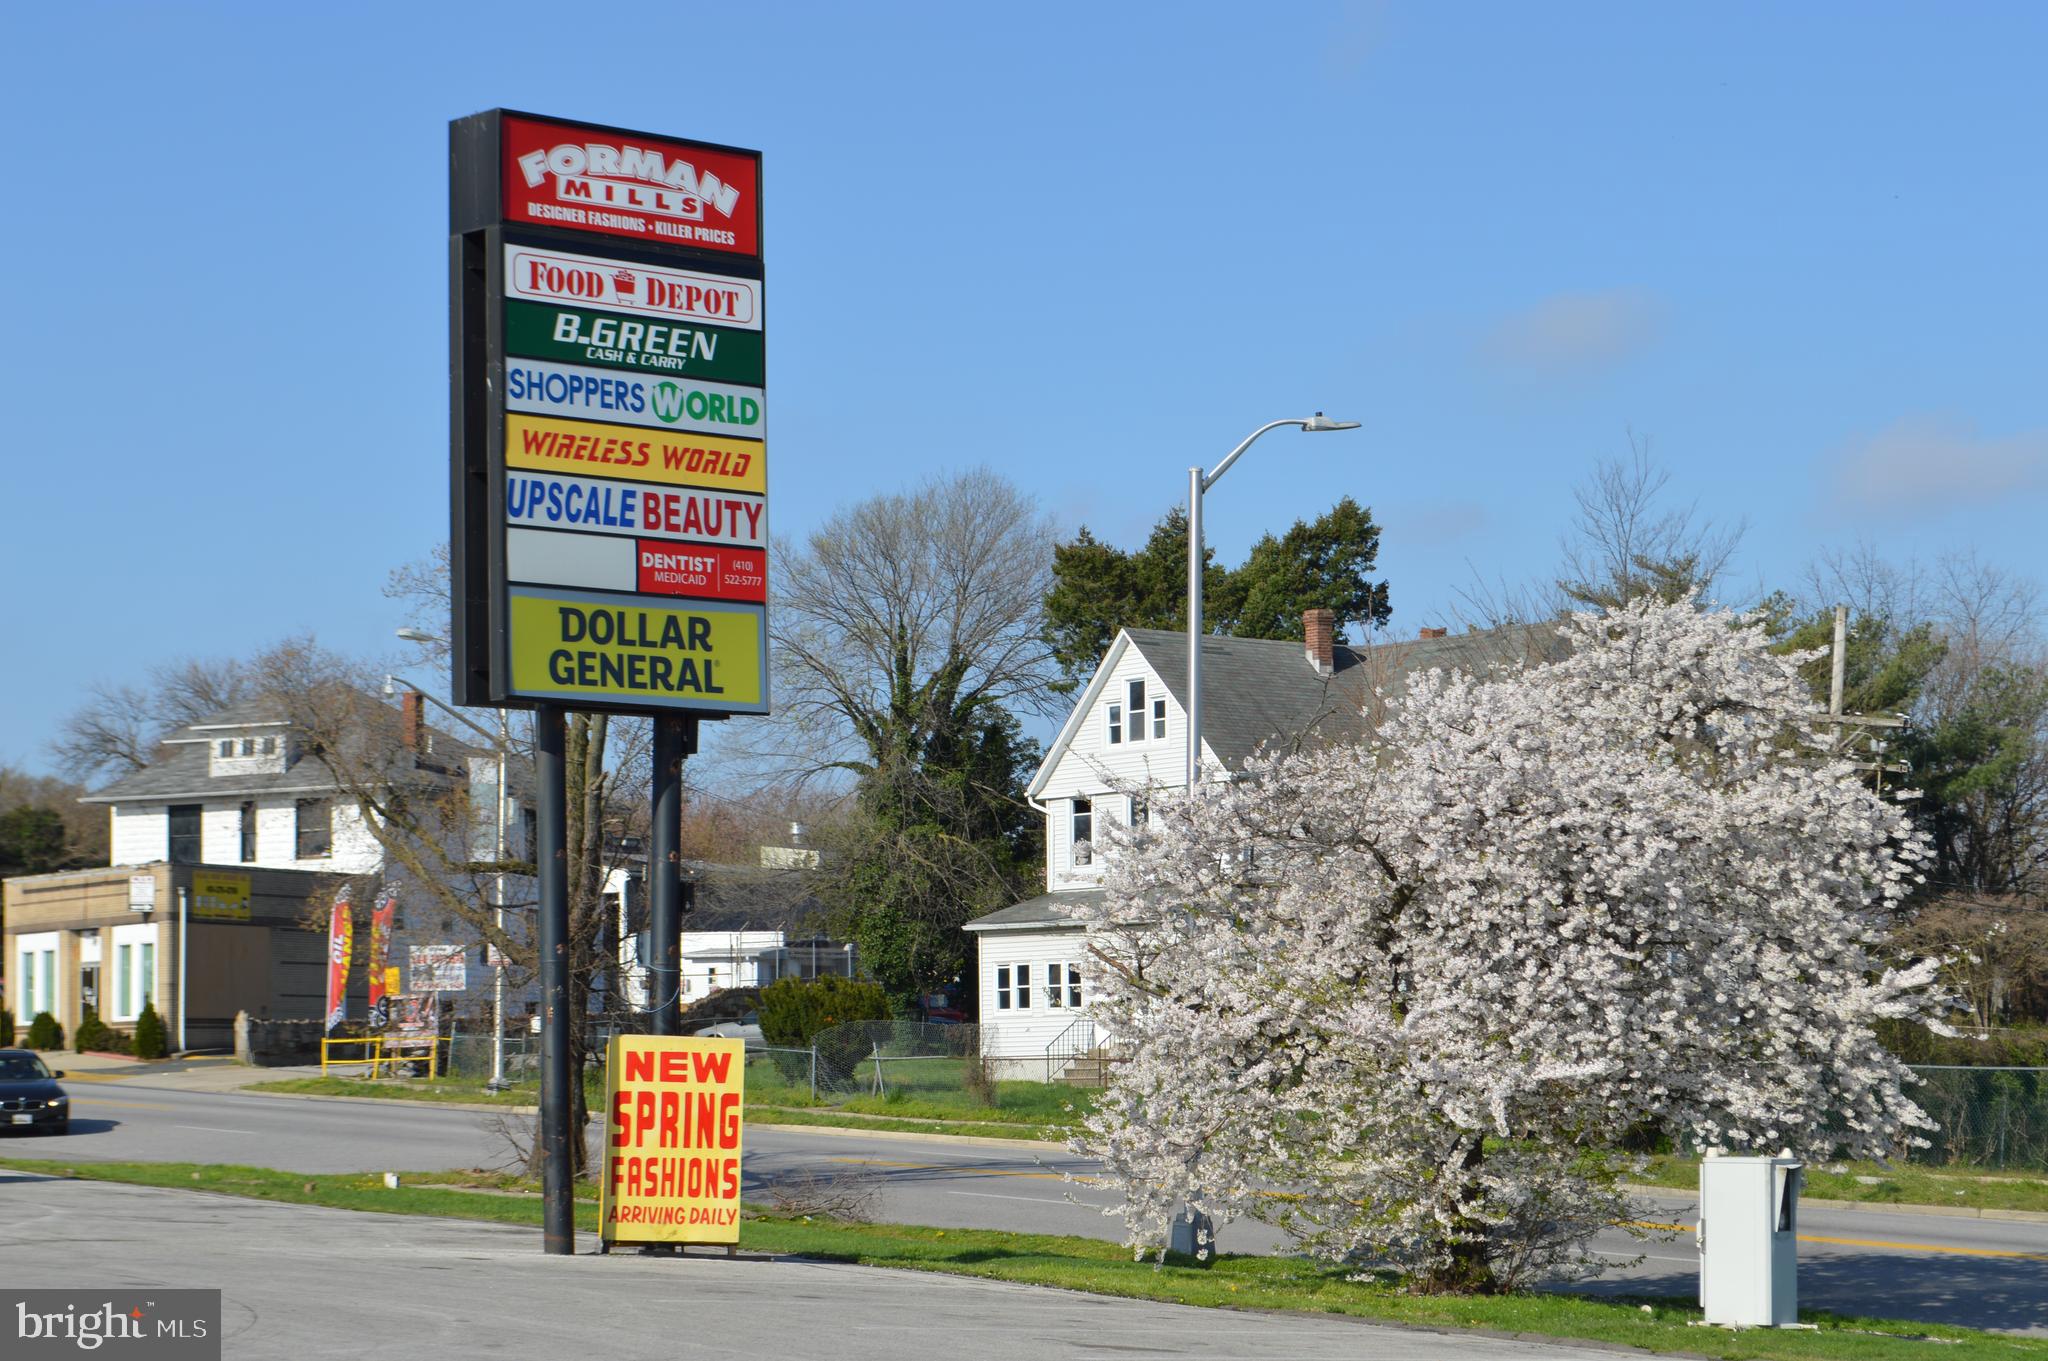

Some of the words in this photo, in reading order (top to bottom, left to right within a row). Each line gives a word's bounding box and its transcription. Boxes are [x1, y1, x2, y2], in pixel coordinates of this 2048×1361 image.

[517, 143, 740, 218] FORMAN
[563, 179, 699, 214] MILLS
[528, 202, 586, 224] DESIGNER
[588, 211, 645, 232] FASHIONS
[655, 220, 692, 240] KILLER
[695, 227, 735, 246] PRICES
[529, 260, 604, 299] FOOD
[645, 277, 739, 317] DEPOT
[586, 346, 623, 363] CASH
[626, 353, 637, 365] &
[640, 354, 686, 370] CARRY
[509, 368, 645, 414] SHOPPERS
[652, 381, 760, 426] WORLD
[522, 429, 652, 467] WIRELESS
[663, 445, 751, 477] WORLD
[508, 478, 637, 528] UPSCALE
[642, 491, 763, 540] BEAUTY
[642, 552, 715, 573] DENTIST
[654, 571, 707, 586] MEDICAID
[724, 574, 762, 586] 522-5777
[732, 560, 754, 573] (410)
[558, 606, 713, 652] DOLLAR
[549, 649, 724, 694] GENERAL
[332, 934, 345, 964] OIL
[625, 1051, 732, 1083] NEW
[612, 1090, 740, 1149] SPRING
[610, 1156, 738, 1199] FASHIONS
[608, 1205, 685, 1225] ARRIVING
[689, 1207, 737, 1226] DAILY
